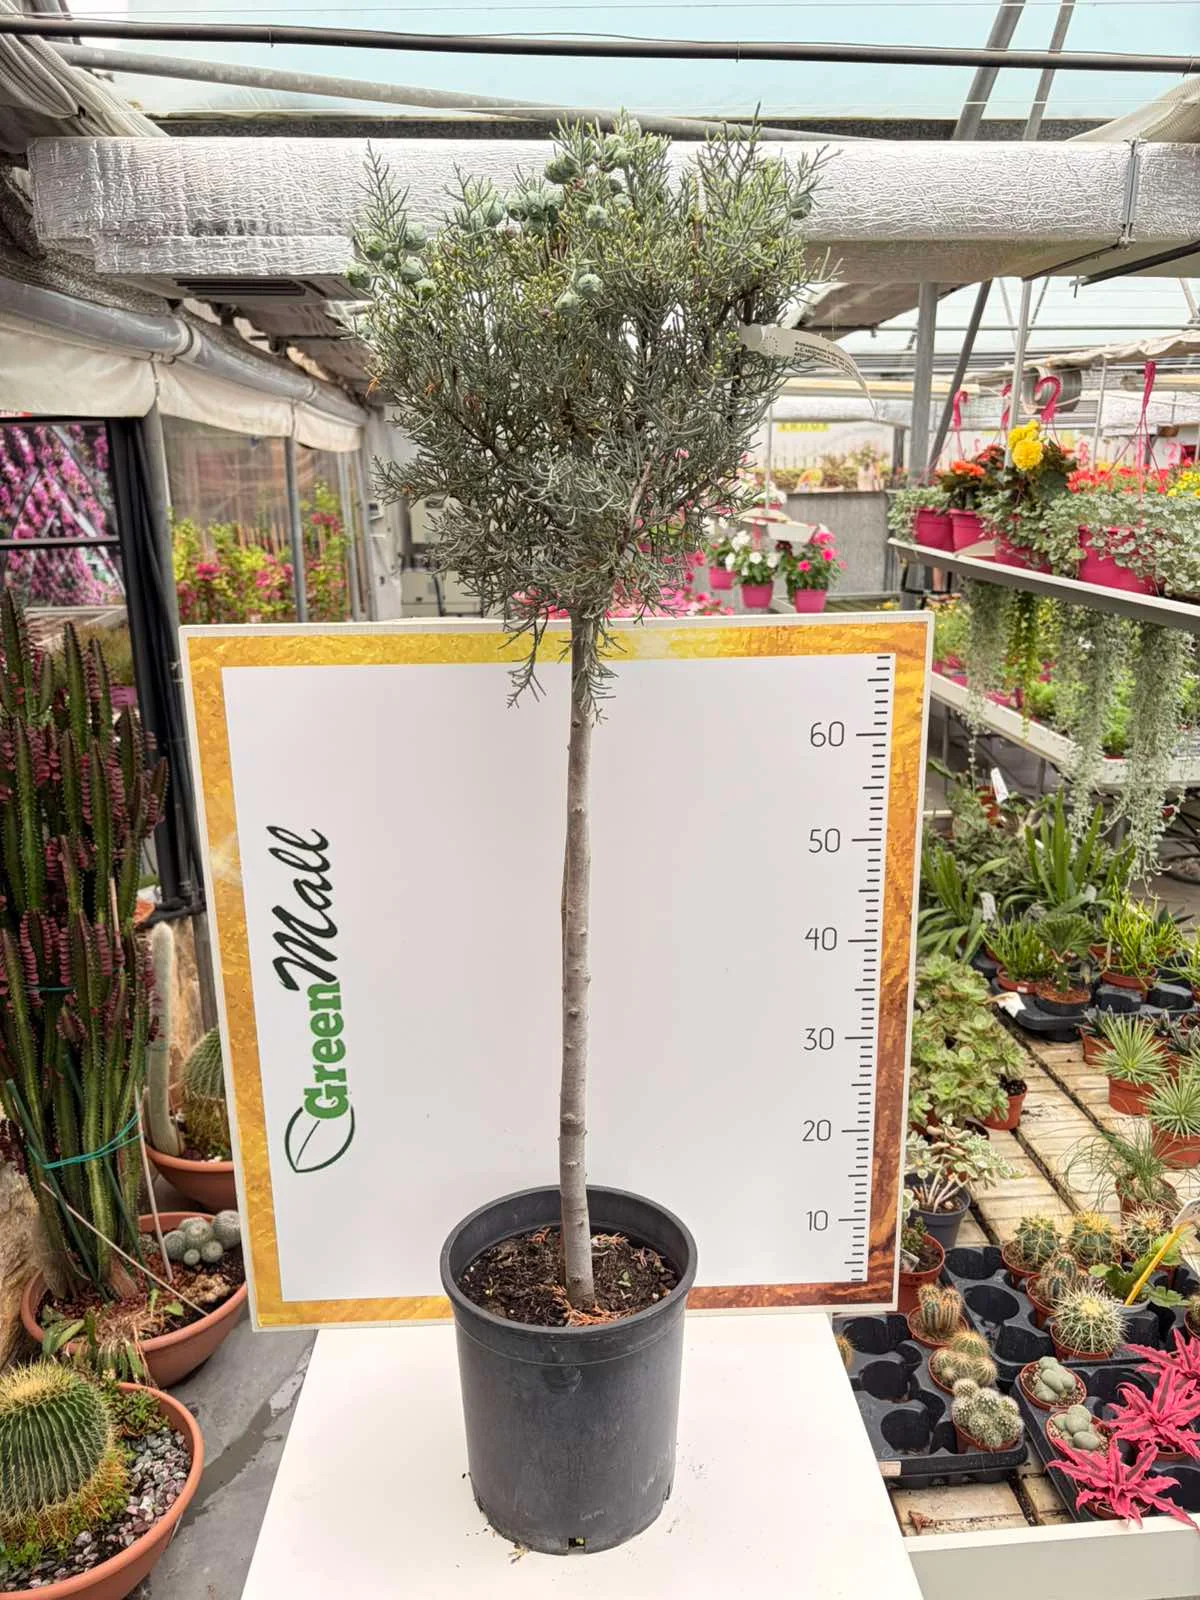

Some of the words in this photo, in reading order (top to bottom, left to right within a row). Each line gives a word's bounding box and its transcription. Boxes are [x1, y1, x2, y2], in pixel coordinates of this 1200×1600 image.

[810, 721, 845, 747] 60
[808, 828, 841, 853] 50
[804, 927, 837, 951] 40
[803, 1027, 835, 1050] 30
[802, 1119, 832, 1142] 20
[805, 1209, 829, 1231] 10
